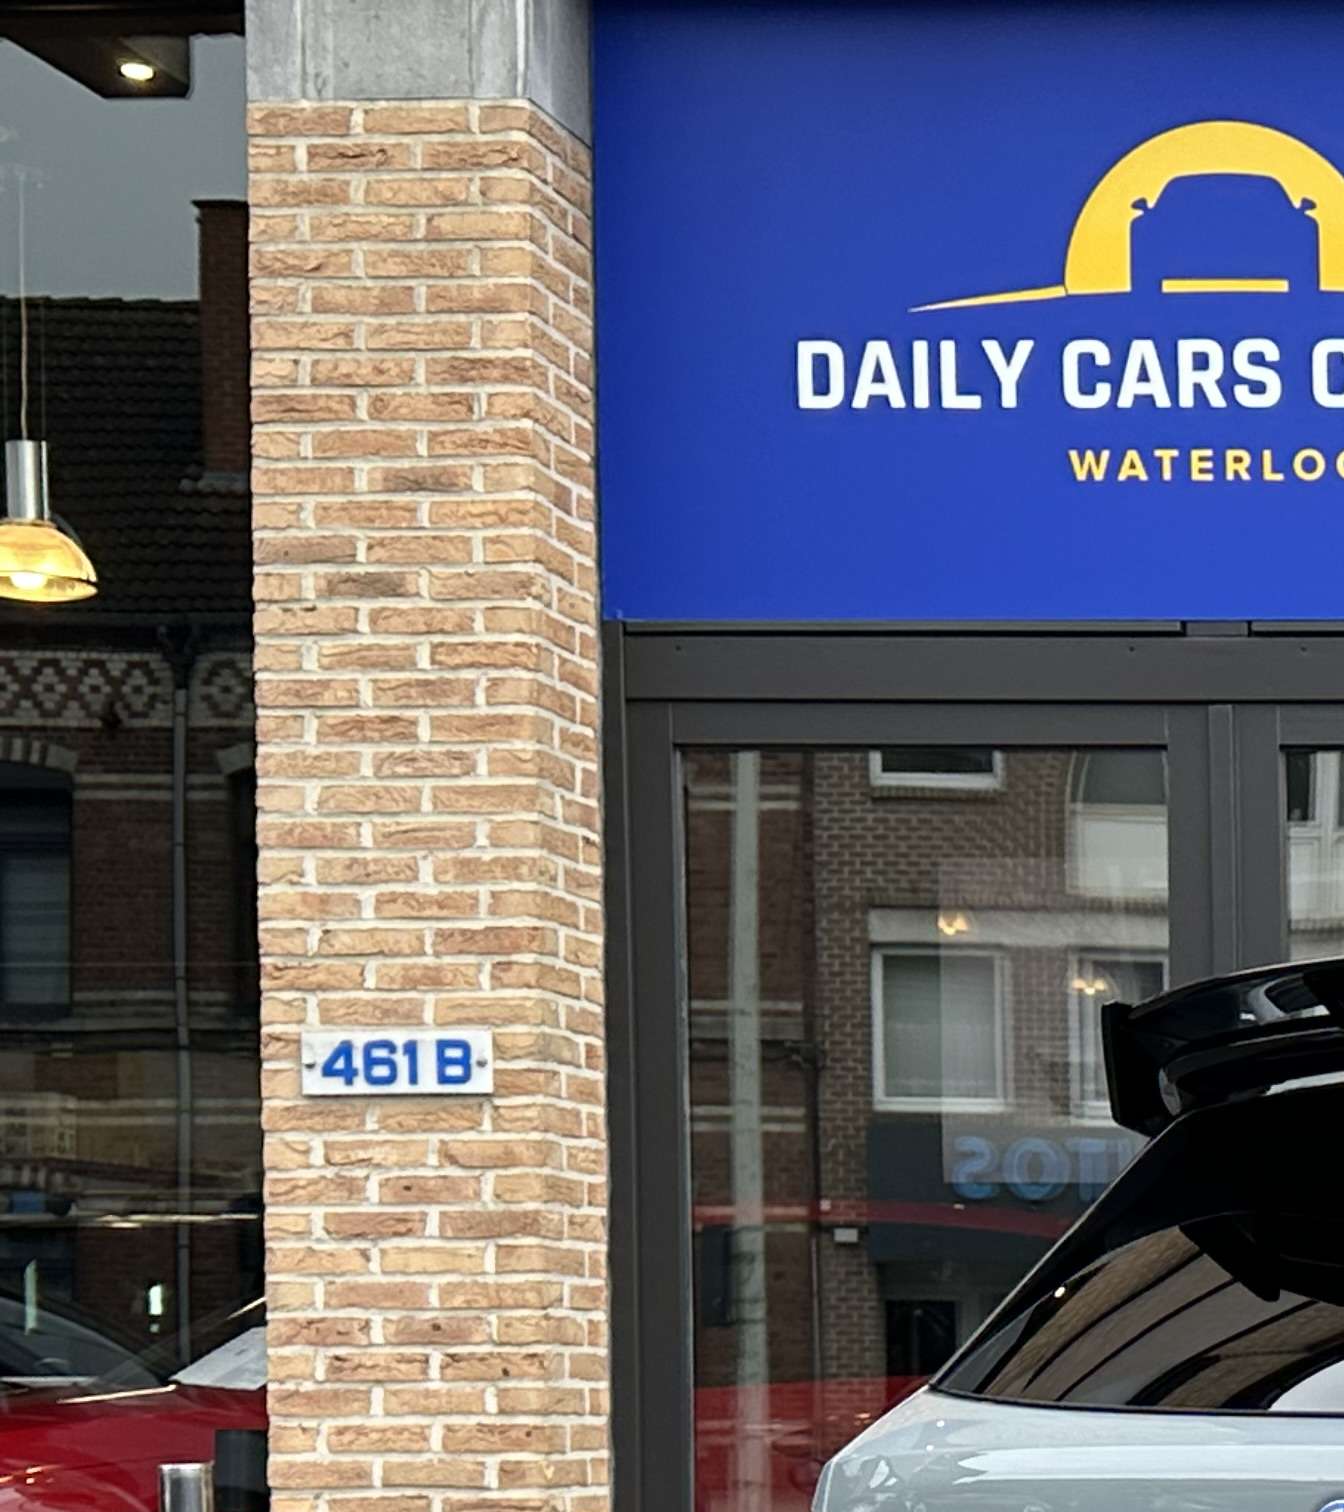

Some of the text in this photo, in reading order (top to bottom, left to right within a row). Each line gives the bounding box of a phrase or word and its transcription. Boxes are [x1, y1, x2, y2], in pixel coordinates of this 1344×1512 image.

[797, 339, 1034, 409] DAILY
[1062, 338, 1282, 408] CARS
[321, 1039, 472, 1086] 461 B
